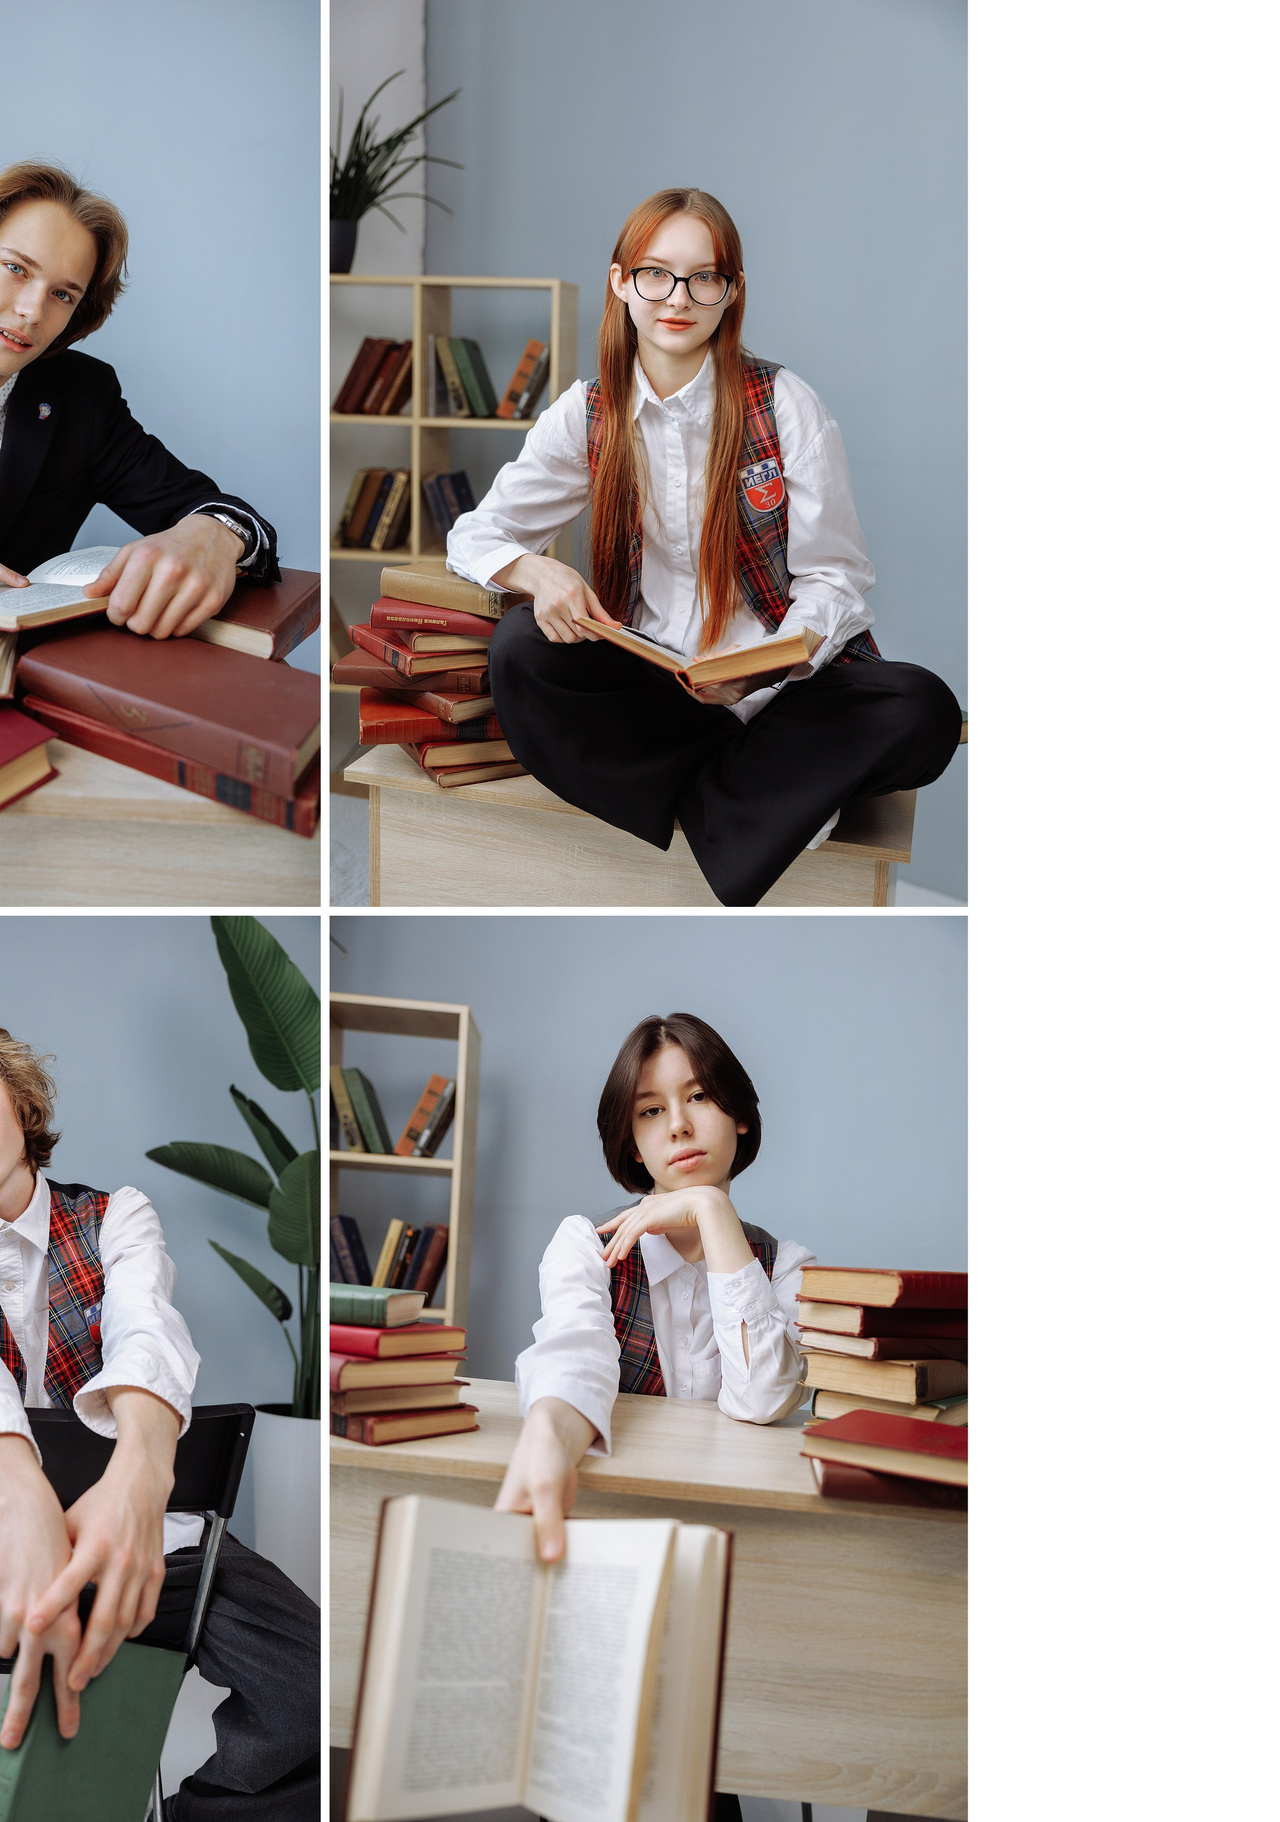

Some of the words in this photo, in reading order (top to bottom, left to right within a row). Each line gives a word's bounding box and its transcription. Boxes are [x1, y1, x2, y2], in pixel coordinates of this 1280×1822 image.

[745, 469, 777, 486] ИЕГЛ
[764, 498, 776, 509] 30
[424, 618, 447, 627] Галина
